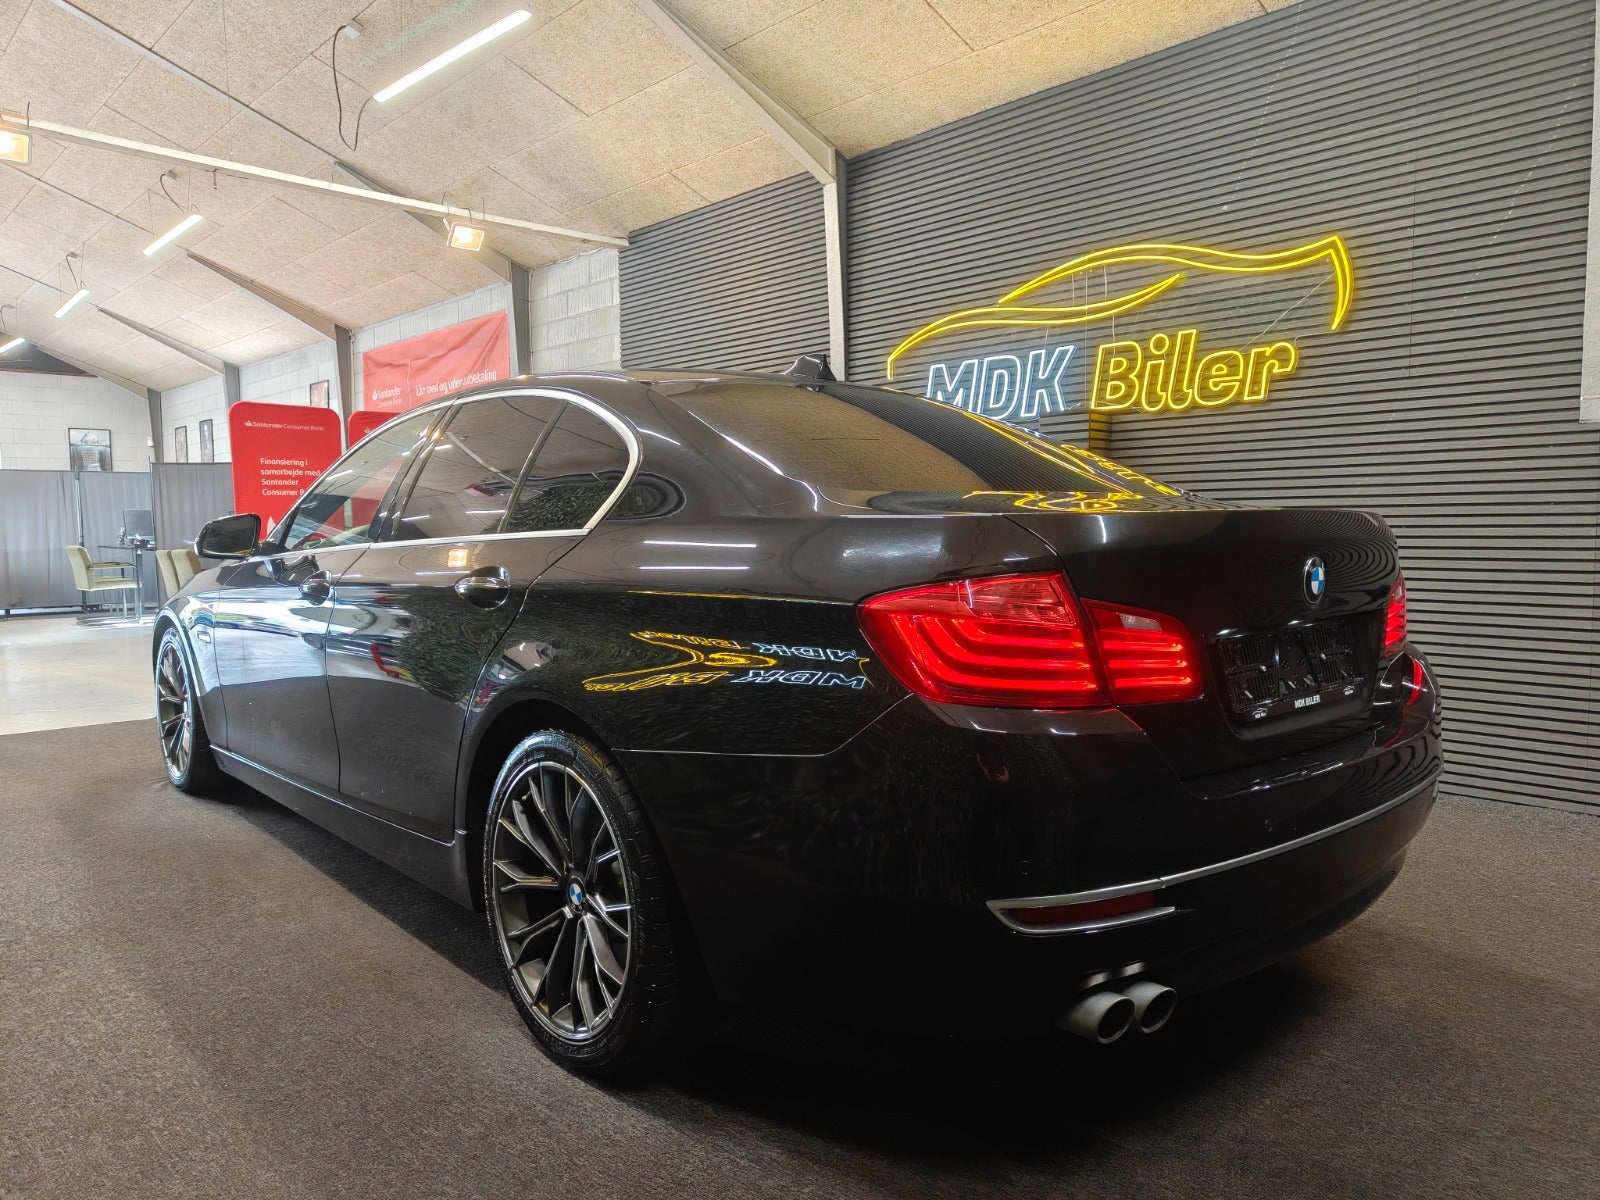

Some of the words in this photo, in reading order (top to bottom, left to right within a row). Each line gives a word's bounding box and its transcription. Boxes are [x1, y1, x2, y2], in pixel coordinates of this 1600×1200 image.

[925, 345, 1076, 421] MDK
[1089, 327, 1297, 412] Biler
[260, 457, 305, 468] Finansiering
[260, 469, 304, 477] samarbejde
[304, 469, 320, 477] med
[261, 478, 299, 486] Santander
[262, 488, 299, 496] Consumer
